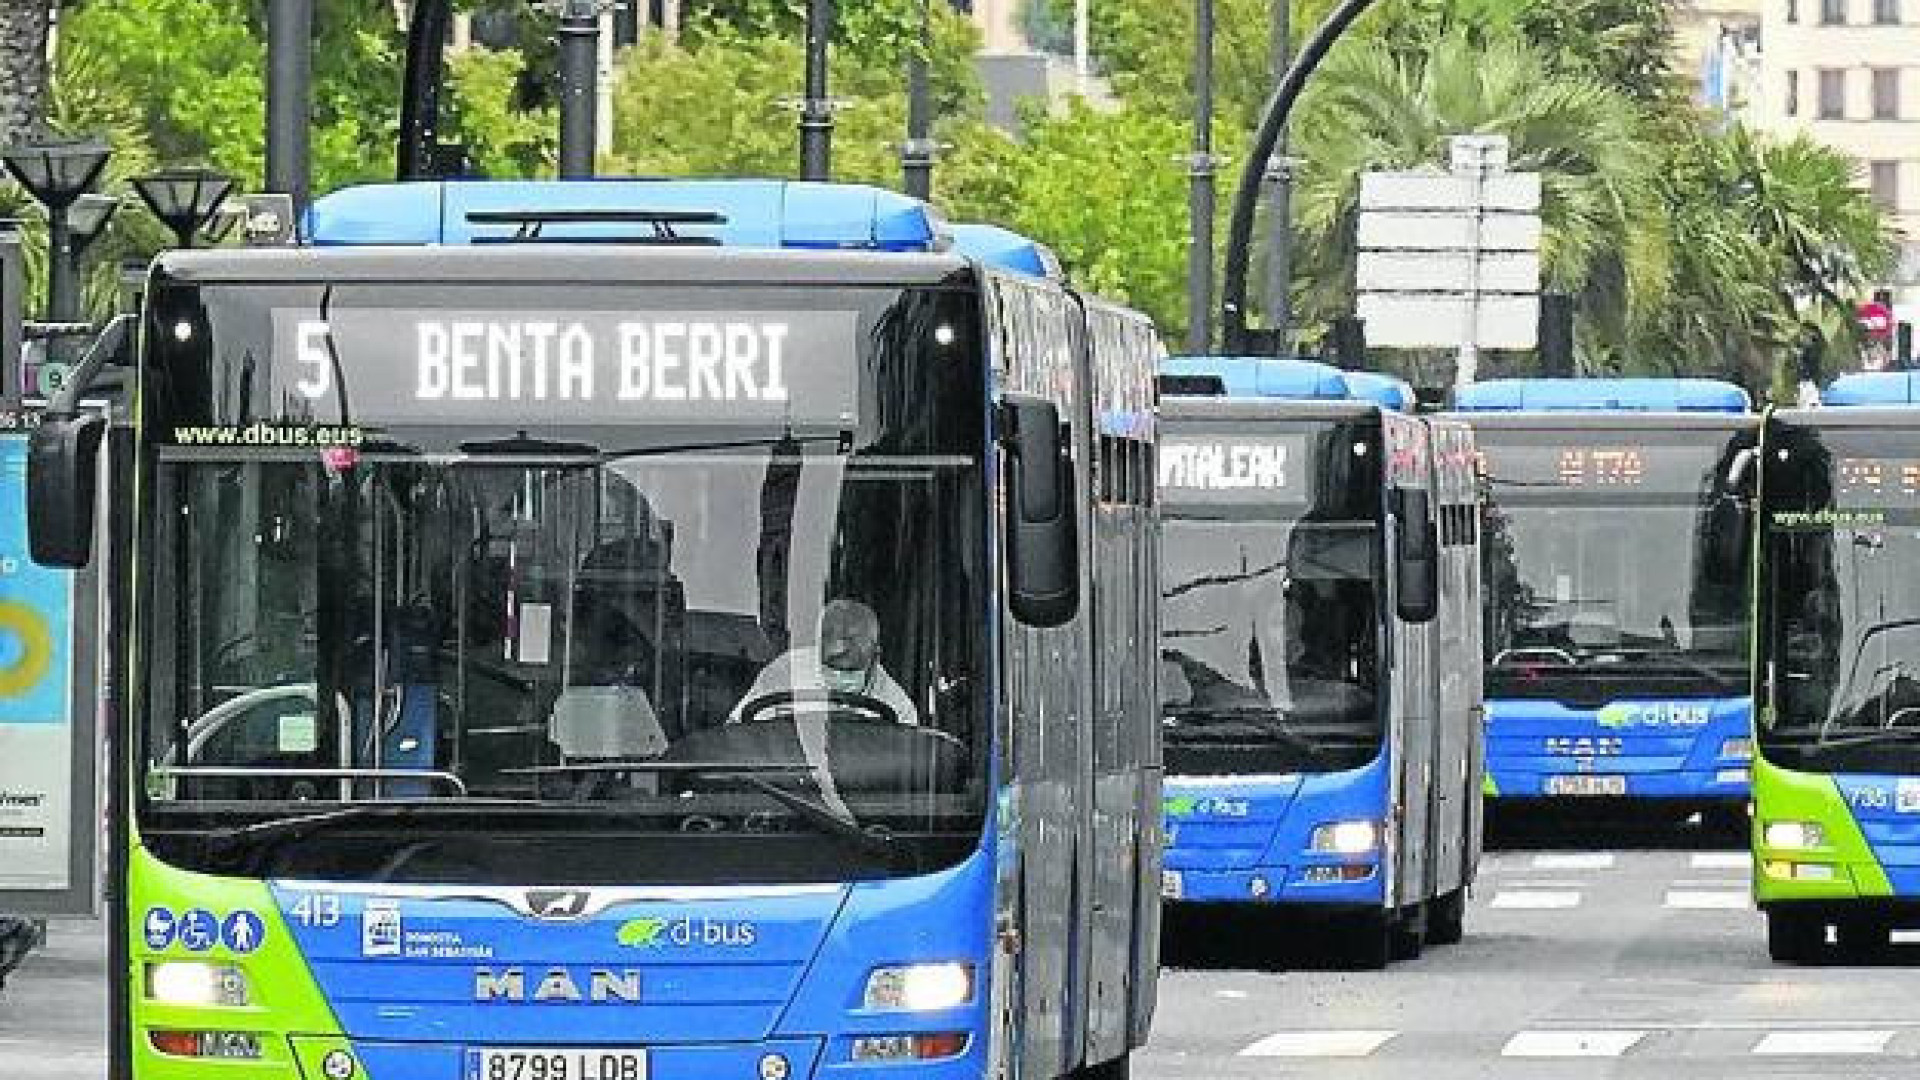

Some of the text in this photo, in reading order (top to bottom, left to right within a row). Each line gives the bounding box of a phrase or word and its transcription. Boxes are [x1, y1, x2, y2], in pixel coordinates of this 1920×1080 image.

[296, 321, 789, 399] 5 BENTA BERRI
[174, 424, 363, 444] www.dbus.eus
[290, 895, 341, 928] 413
[475, 967, 642, 1003] MAN
[488, 1053, 567, 1080] 8799
